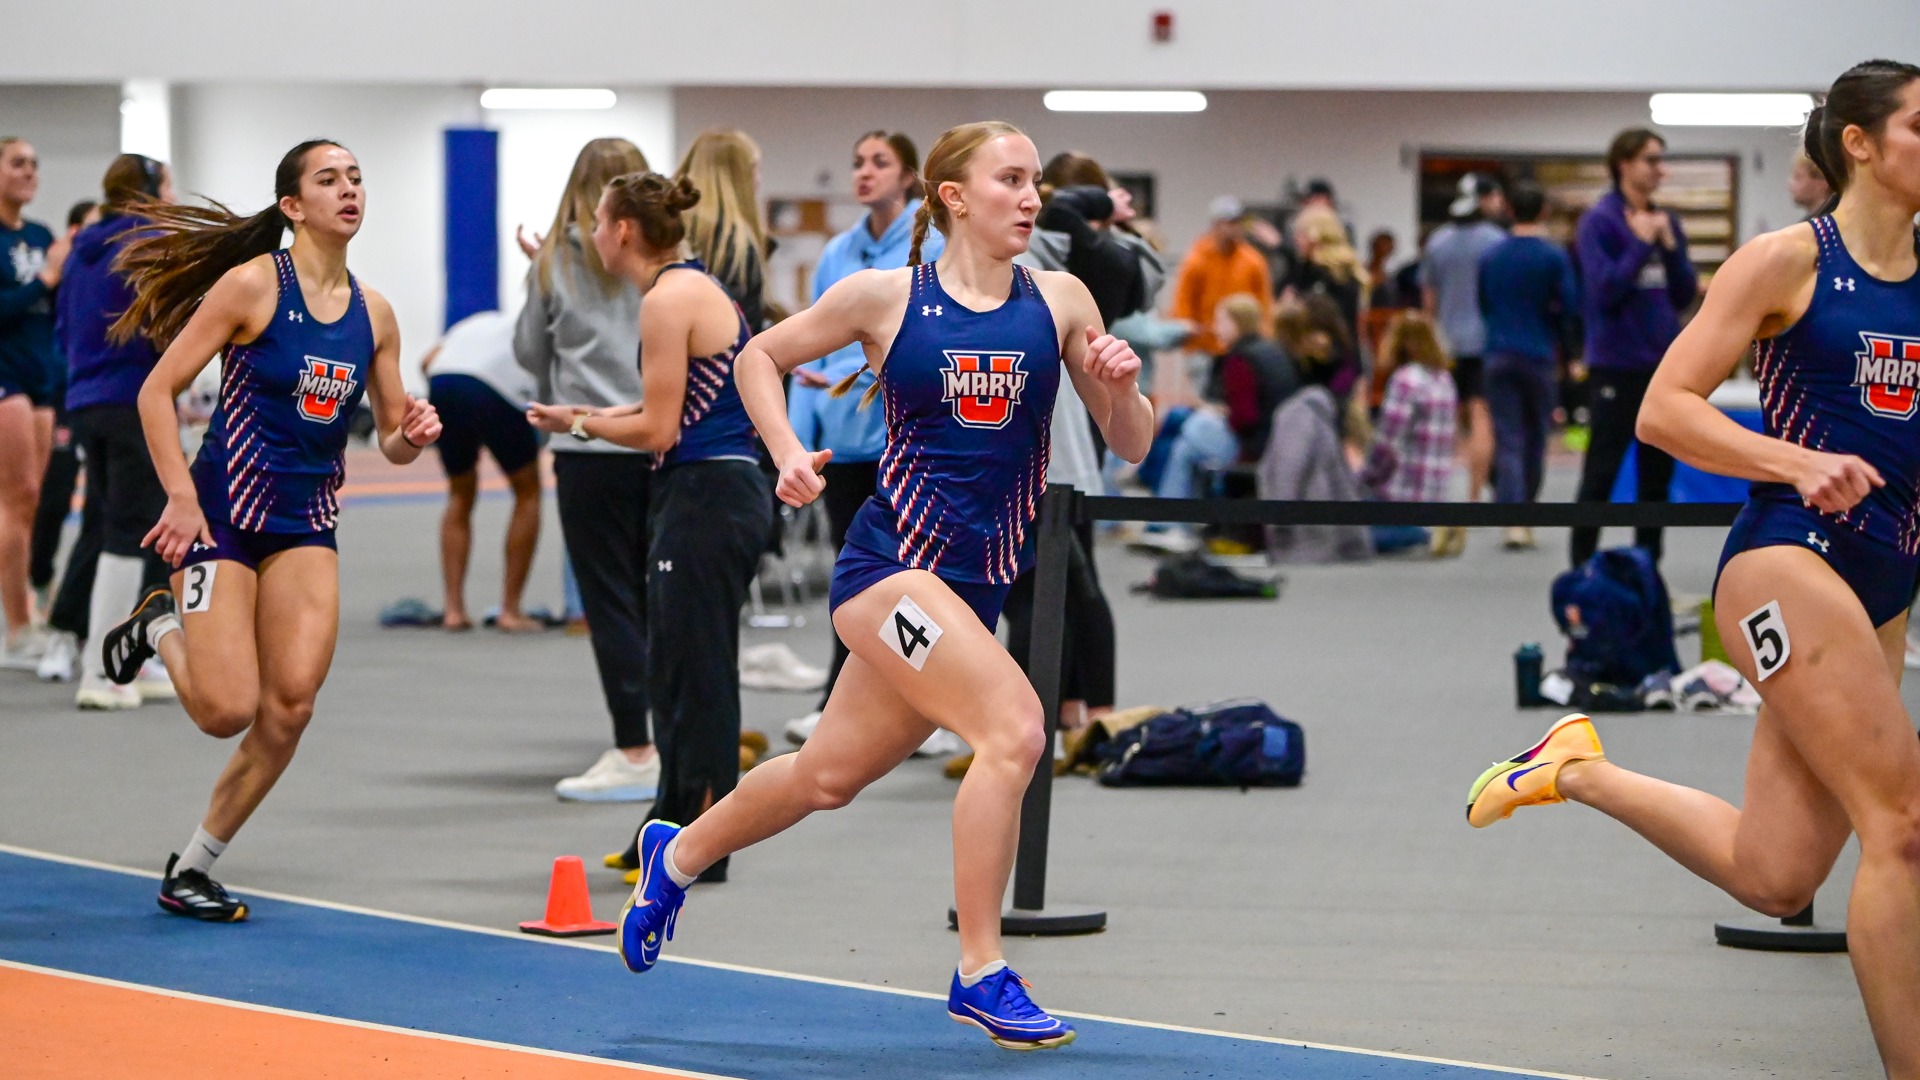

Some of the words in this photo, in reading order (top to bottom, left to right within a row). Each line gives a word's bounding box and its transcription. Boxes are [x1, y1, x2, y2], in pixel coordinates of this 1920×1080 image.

[297, 355, 356, 424] U
[299, 374, 354, 402] MARY
[942, 350, 1025, 429] U
[948, 371, 1025, 401] MARY
[1861, 356, 1920, 387] MAR
[186, 565, 207, 610] 3
[894, 611, 931, 659] 4
[1747, 609, 1783, 671] 5
